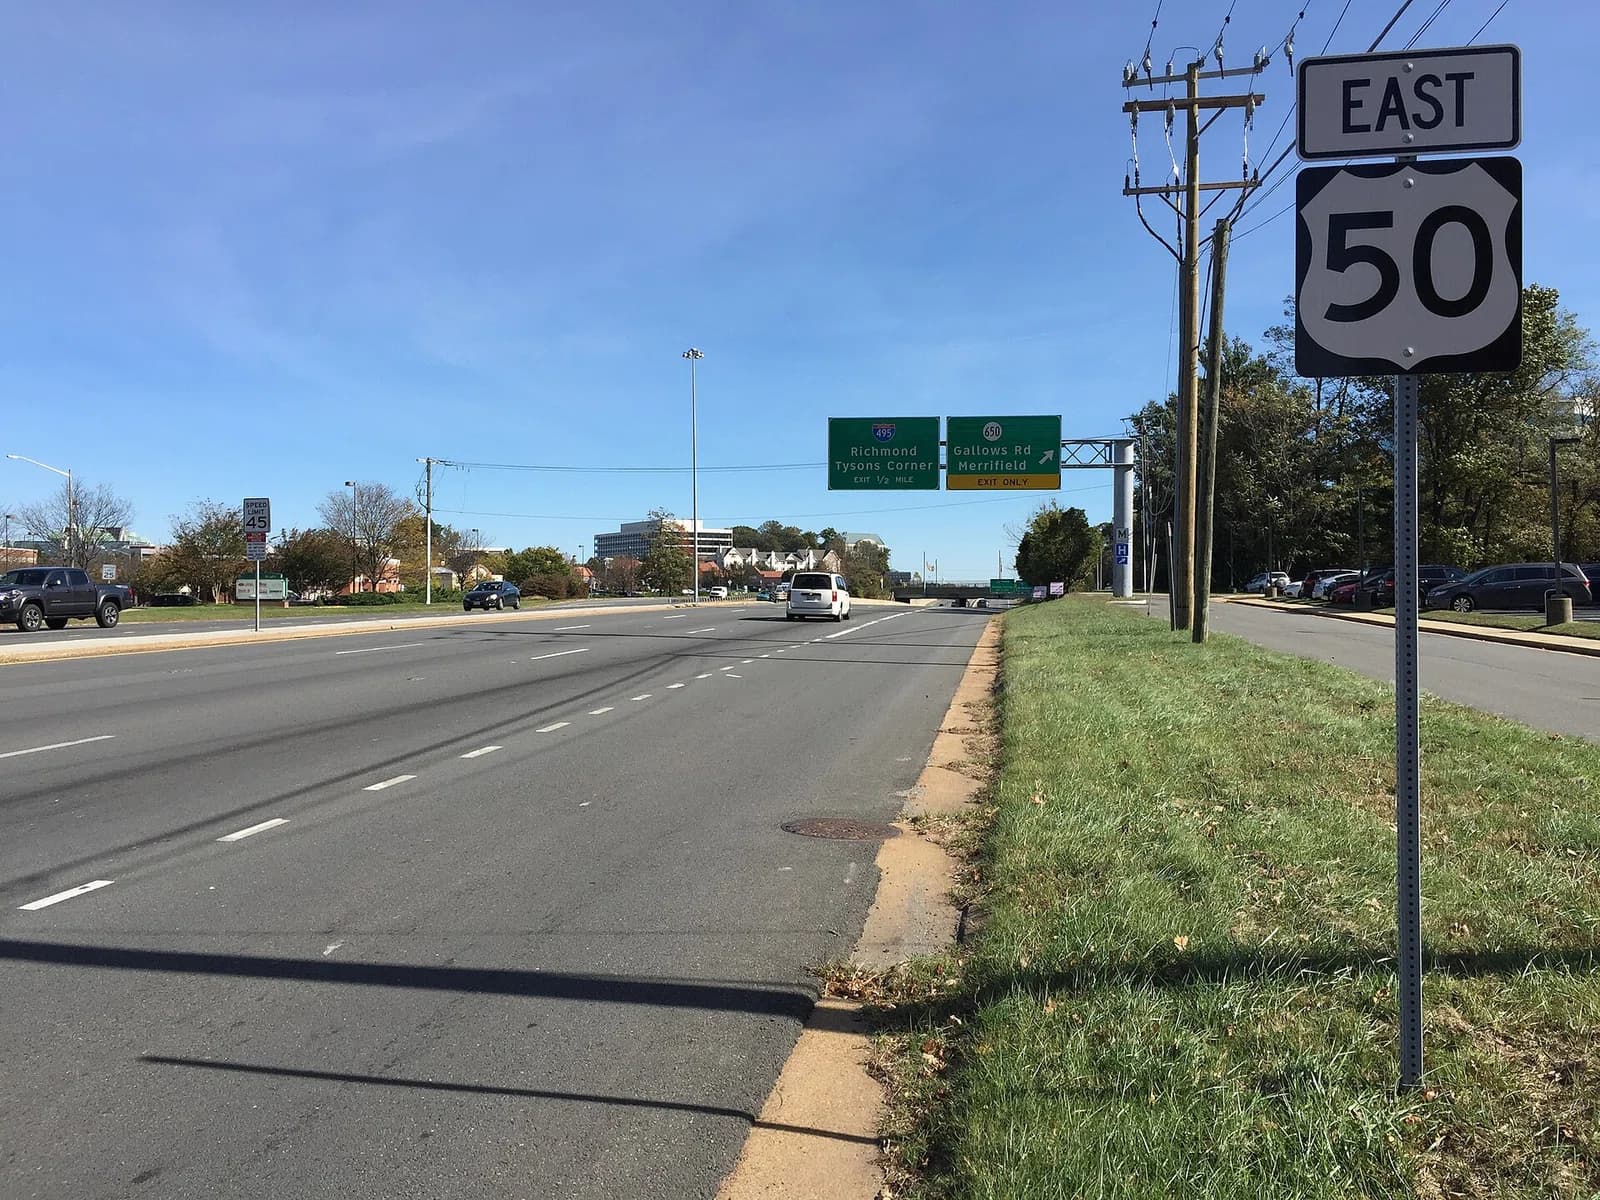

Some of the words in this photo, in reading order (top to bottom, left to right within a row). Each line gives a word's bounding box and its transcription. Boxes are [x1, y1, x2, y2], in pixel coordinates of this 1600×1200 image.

[1342, 72, 1474, 134] EAST
[1324, 205, 1493, 323] 50
[876, 428, 892, 438] 495
[984, 426, 1000, 437] 650
[850, 446, 917, 457] Richmond
[953, 445, 1008, 456] Gallows
[1014, 444, 1031, 455] Rd
[835, 461, 880, 473] Tysons
[887, 461, 933, 471] Corner
[958, 460, 1027, 471] Merrifield
[977, 478, 997, 486] EXIT
[1003, 478, 1030, 486] ONLY
[245, 516, 267, 528] 45
[1118, 529, 1127, 539] M
[1118, 545, 1126, 555] H
